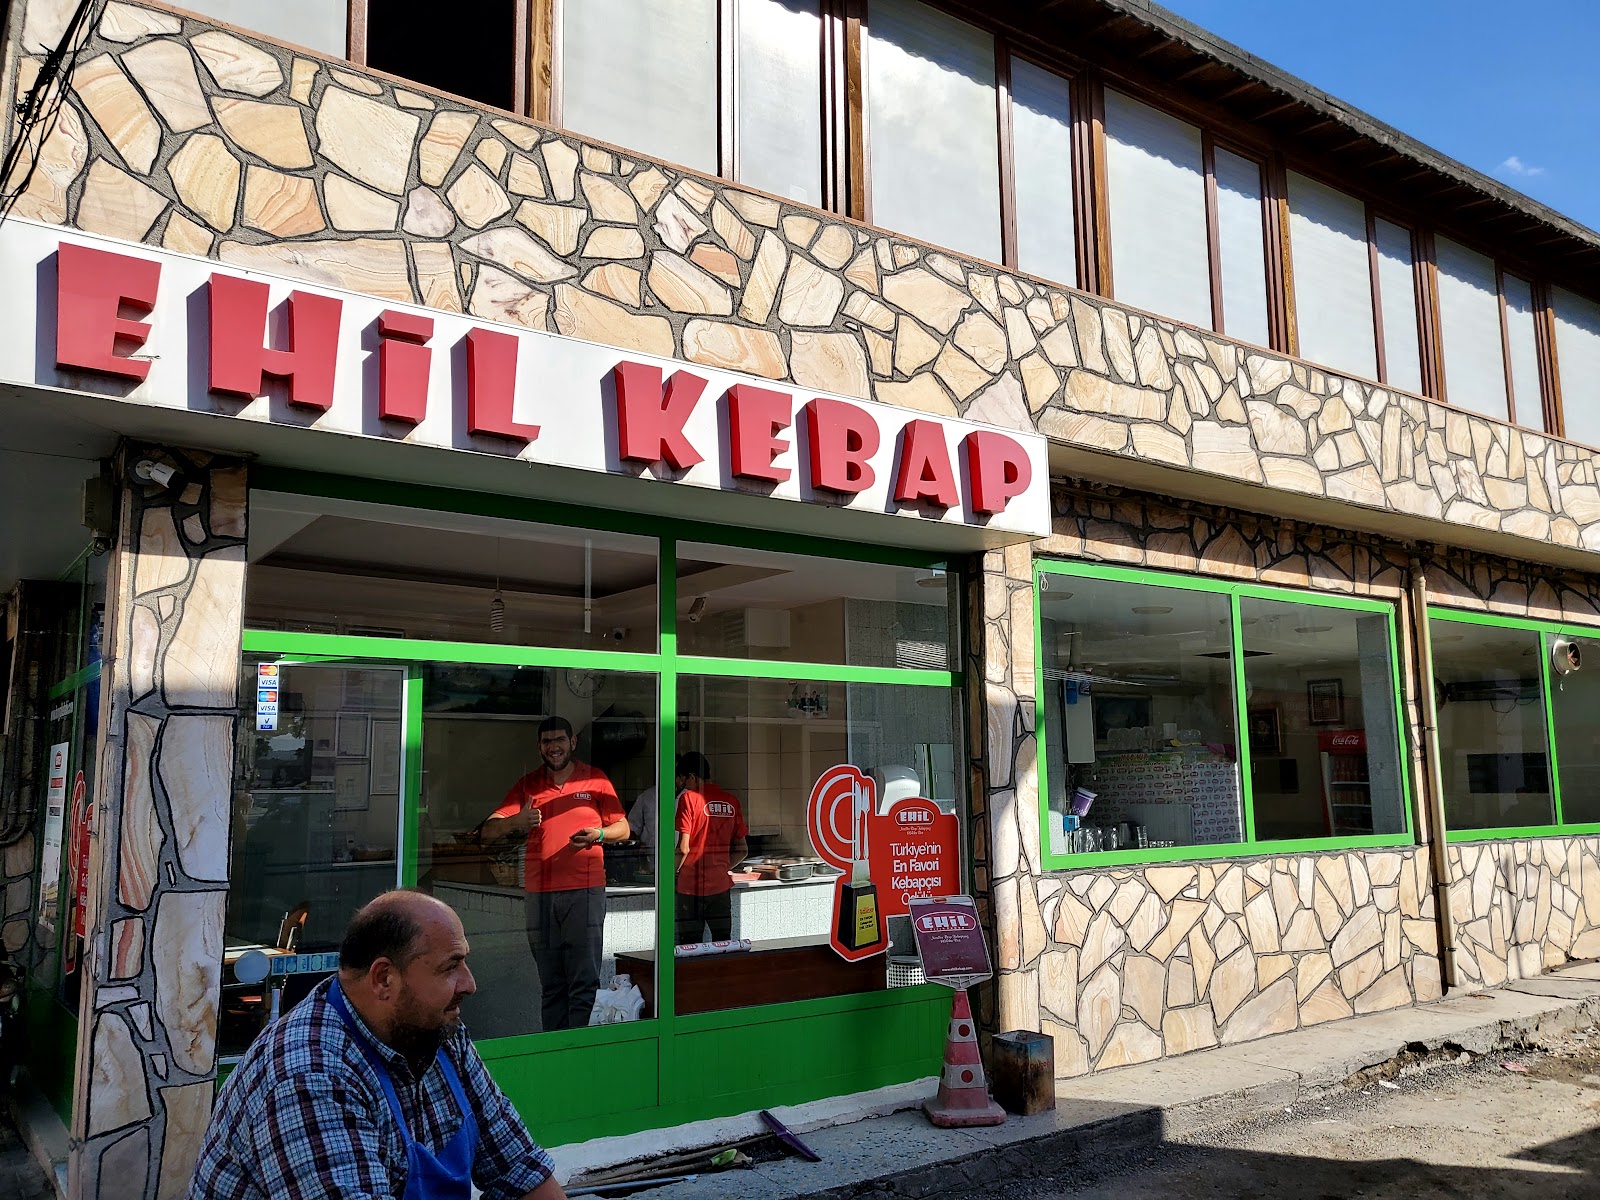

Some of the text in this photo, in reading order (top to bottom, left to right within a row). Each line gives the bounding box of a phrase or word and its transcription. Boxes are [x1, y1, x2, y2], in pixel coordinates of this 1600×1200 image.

[614, 360, 1033, 515] KEBAP
[889, 842, 942, 859] Türkiye'nin
[893, 857, 940, 873] En Favori
[891, 875, 942, 891] Kebapçısı
